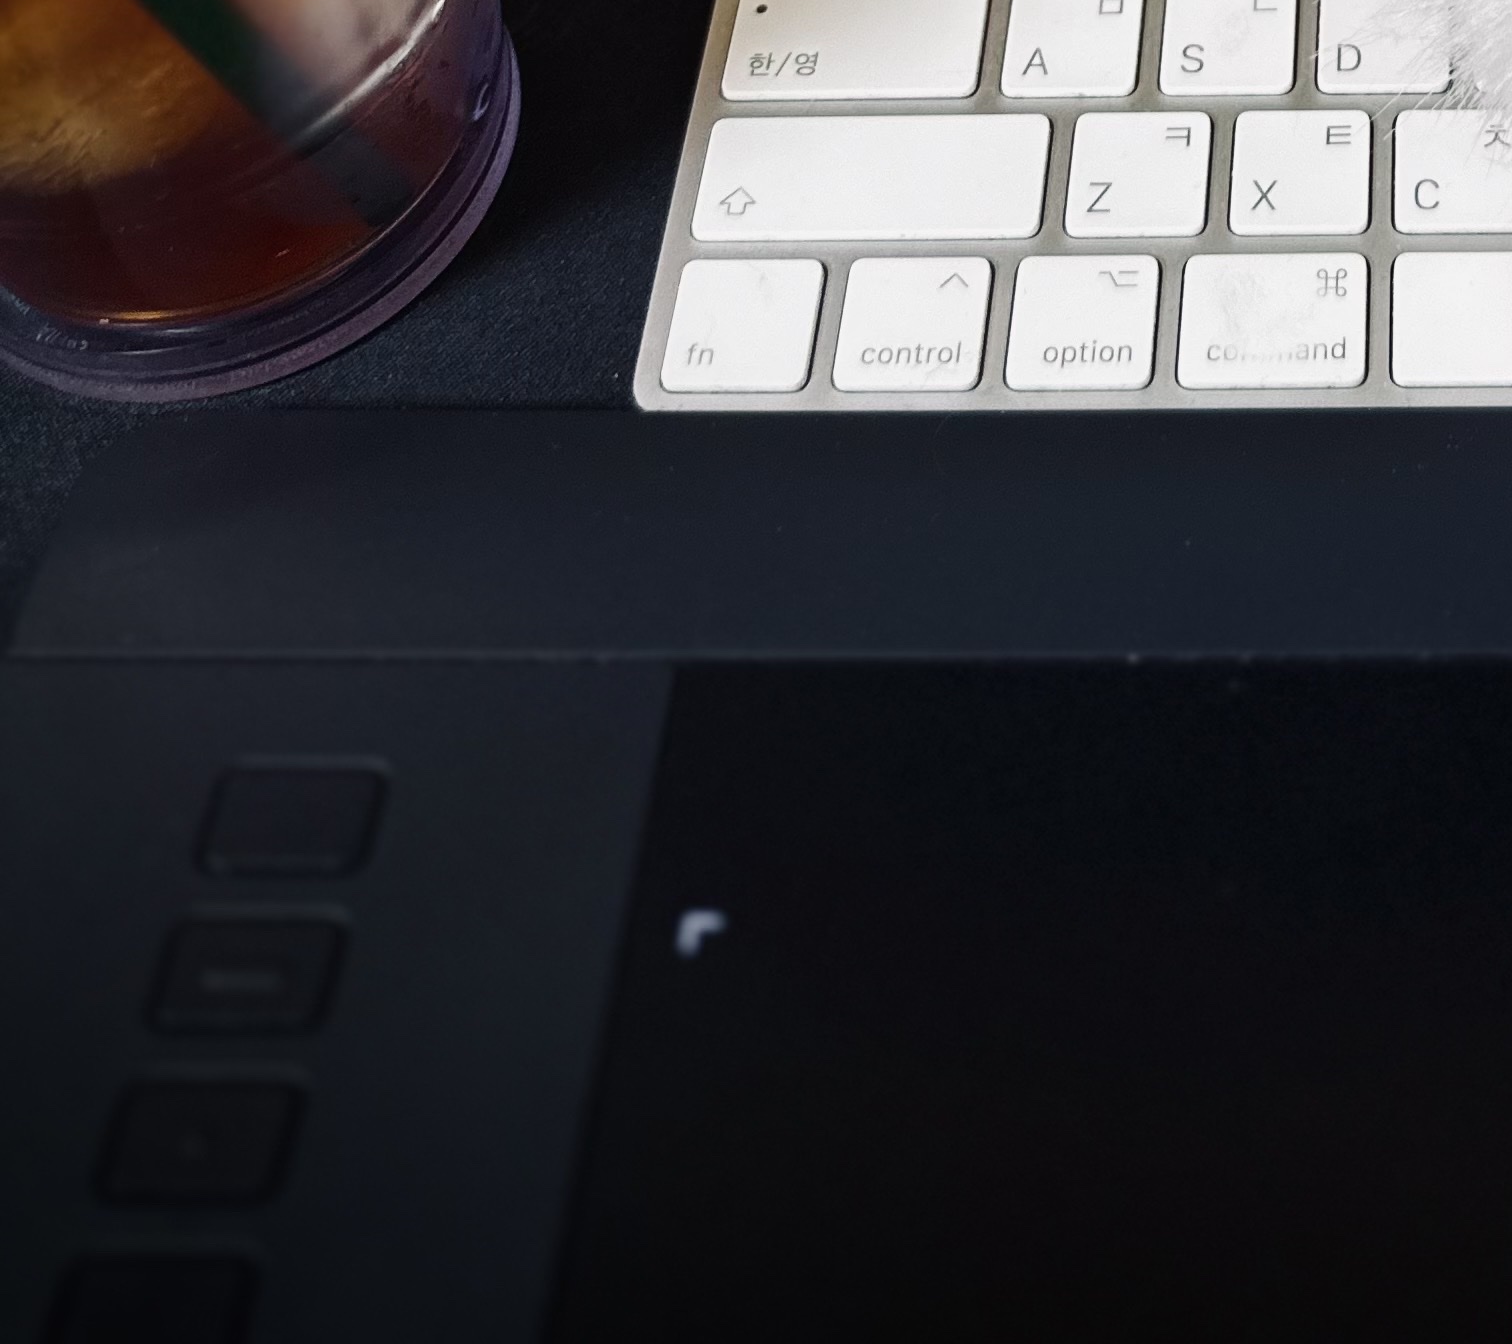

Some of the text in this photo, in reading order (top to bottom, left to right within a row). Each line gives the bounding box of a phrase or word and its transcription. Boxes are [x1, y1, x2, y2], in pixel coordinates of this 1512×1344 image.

[748, 51, 820, 78] 한/영
[1021, 47, 1049, 77] A
[1180, 43, 1205, 74] S
[1336, 43, 1362, 73] D
[1086, 181, 1113, 214] Z
[1251, 179, 1278, 211] X
[1413, 178, 1440, 210] C
[686, 342, 715, 366] fn
[860, 341, 962, 366] control
[1042, 339, 1133, 369] option
[1206, 336, 1347, 362] coand
